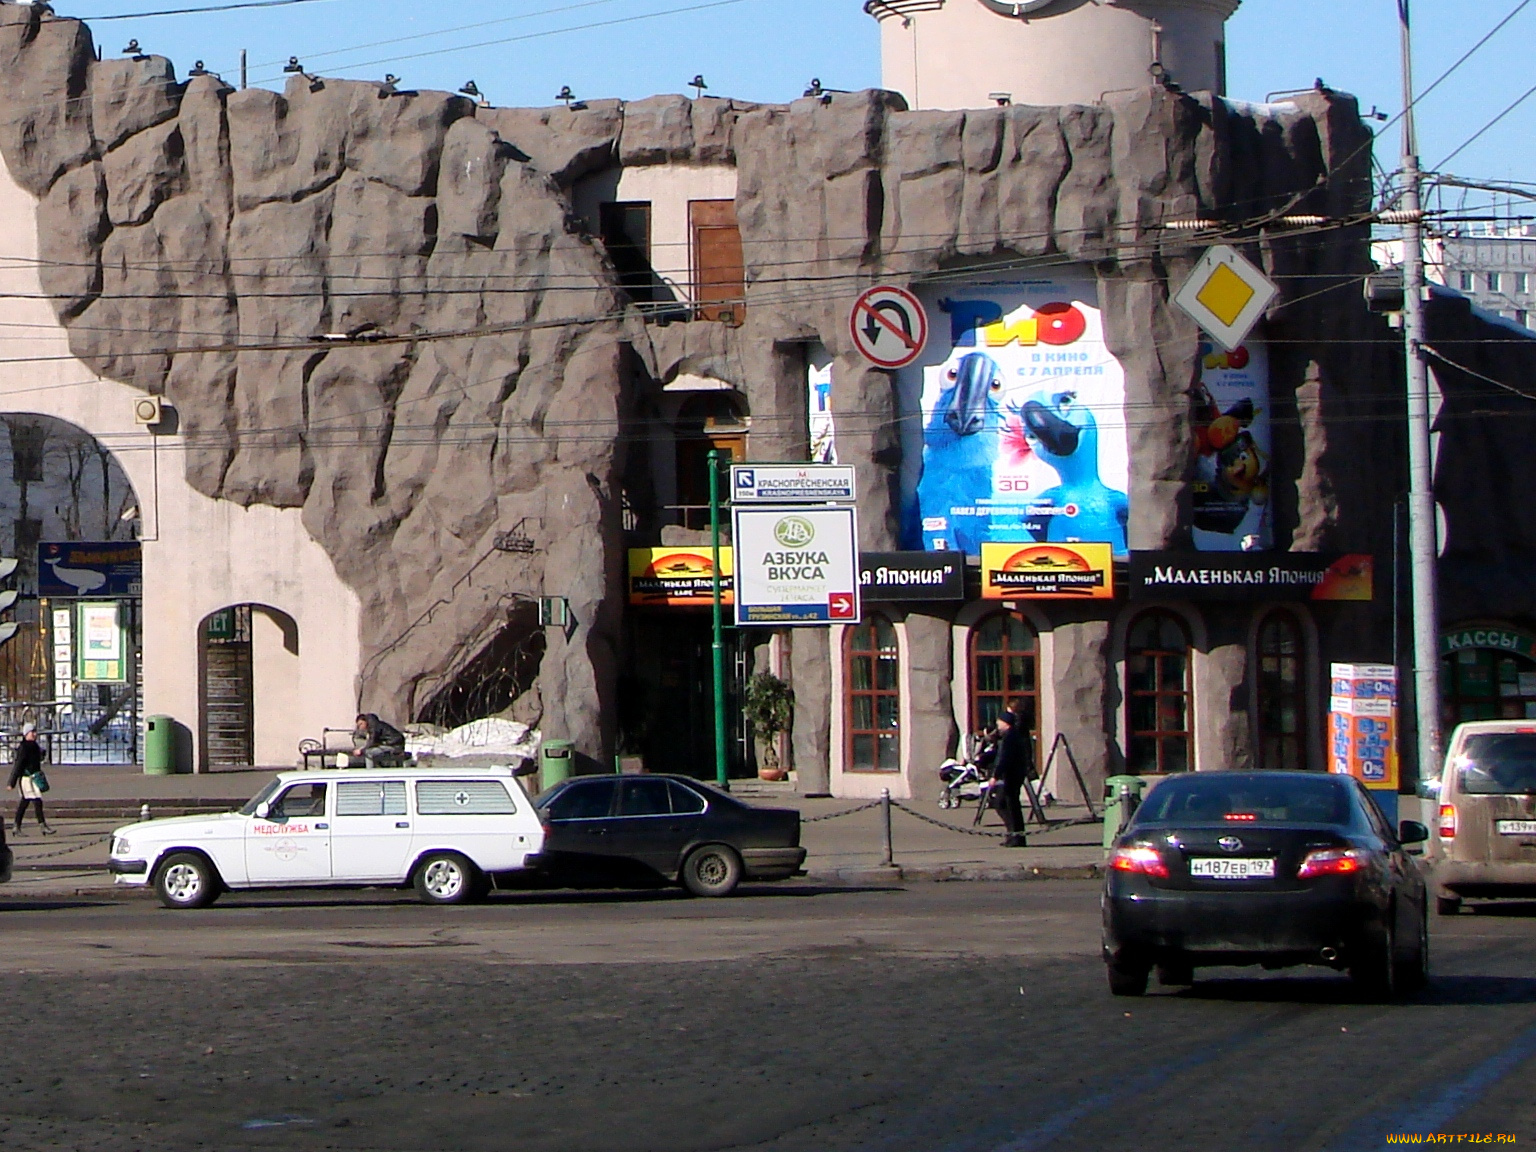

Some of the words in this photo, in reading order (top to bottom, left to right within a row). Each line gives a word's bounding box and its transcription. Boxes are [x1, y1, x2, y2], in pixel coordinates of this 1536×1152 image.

[1045, 352, 1089, 362] КИНО
[1027, 366, 1037, 376] 7
[1041, 365, 1104, 376] АПРЕЛЯ
[758, 478, 849, 488] КРАСНОПРЕСНЕНСКАЯ
[998, 480, 1029, 491] 3D
[762, 551, 830, 565] АЗБУКА
[768, 566, 825, 580] ВКУСА
[766, 584, 827, 594] СУПЕРМАРКЕТ
[1447, 631, 1518, 649] КАССЫ
[1363, 760, 1384, 776] 0%
[254, 824, 309, 835] МЕДСЛУЖБА
